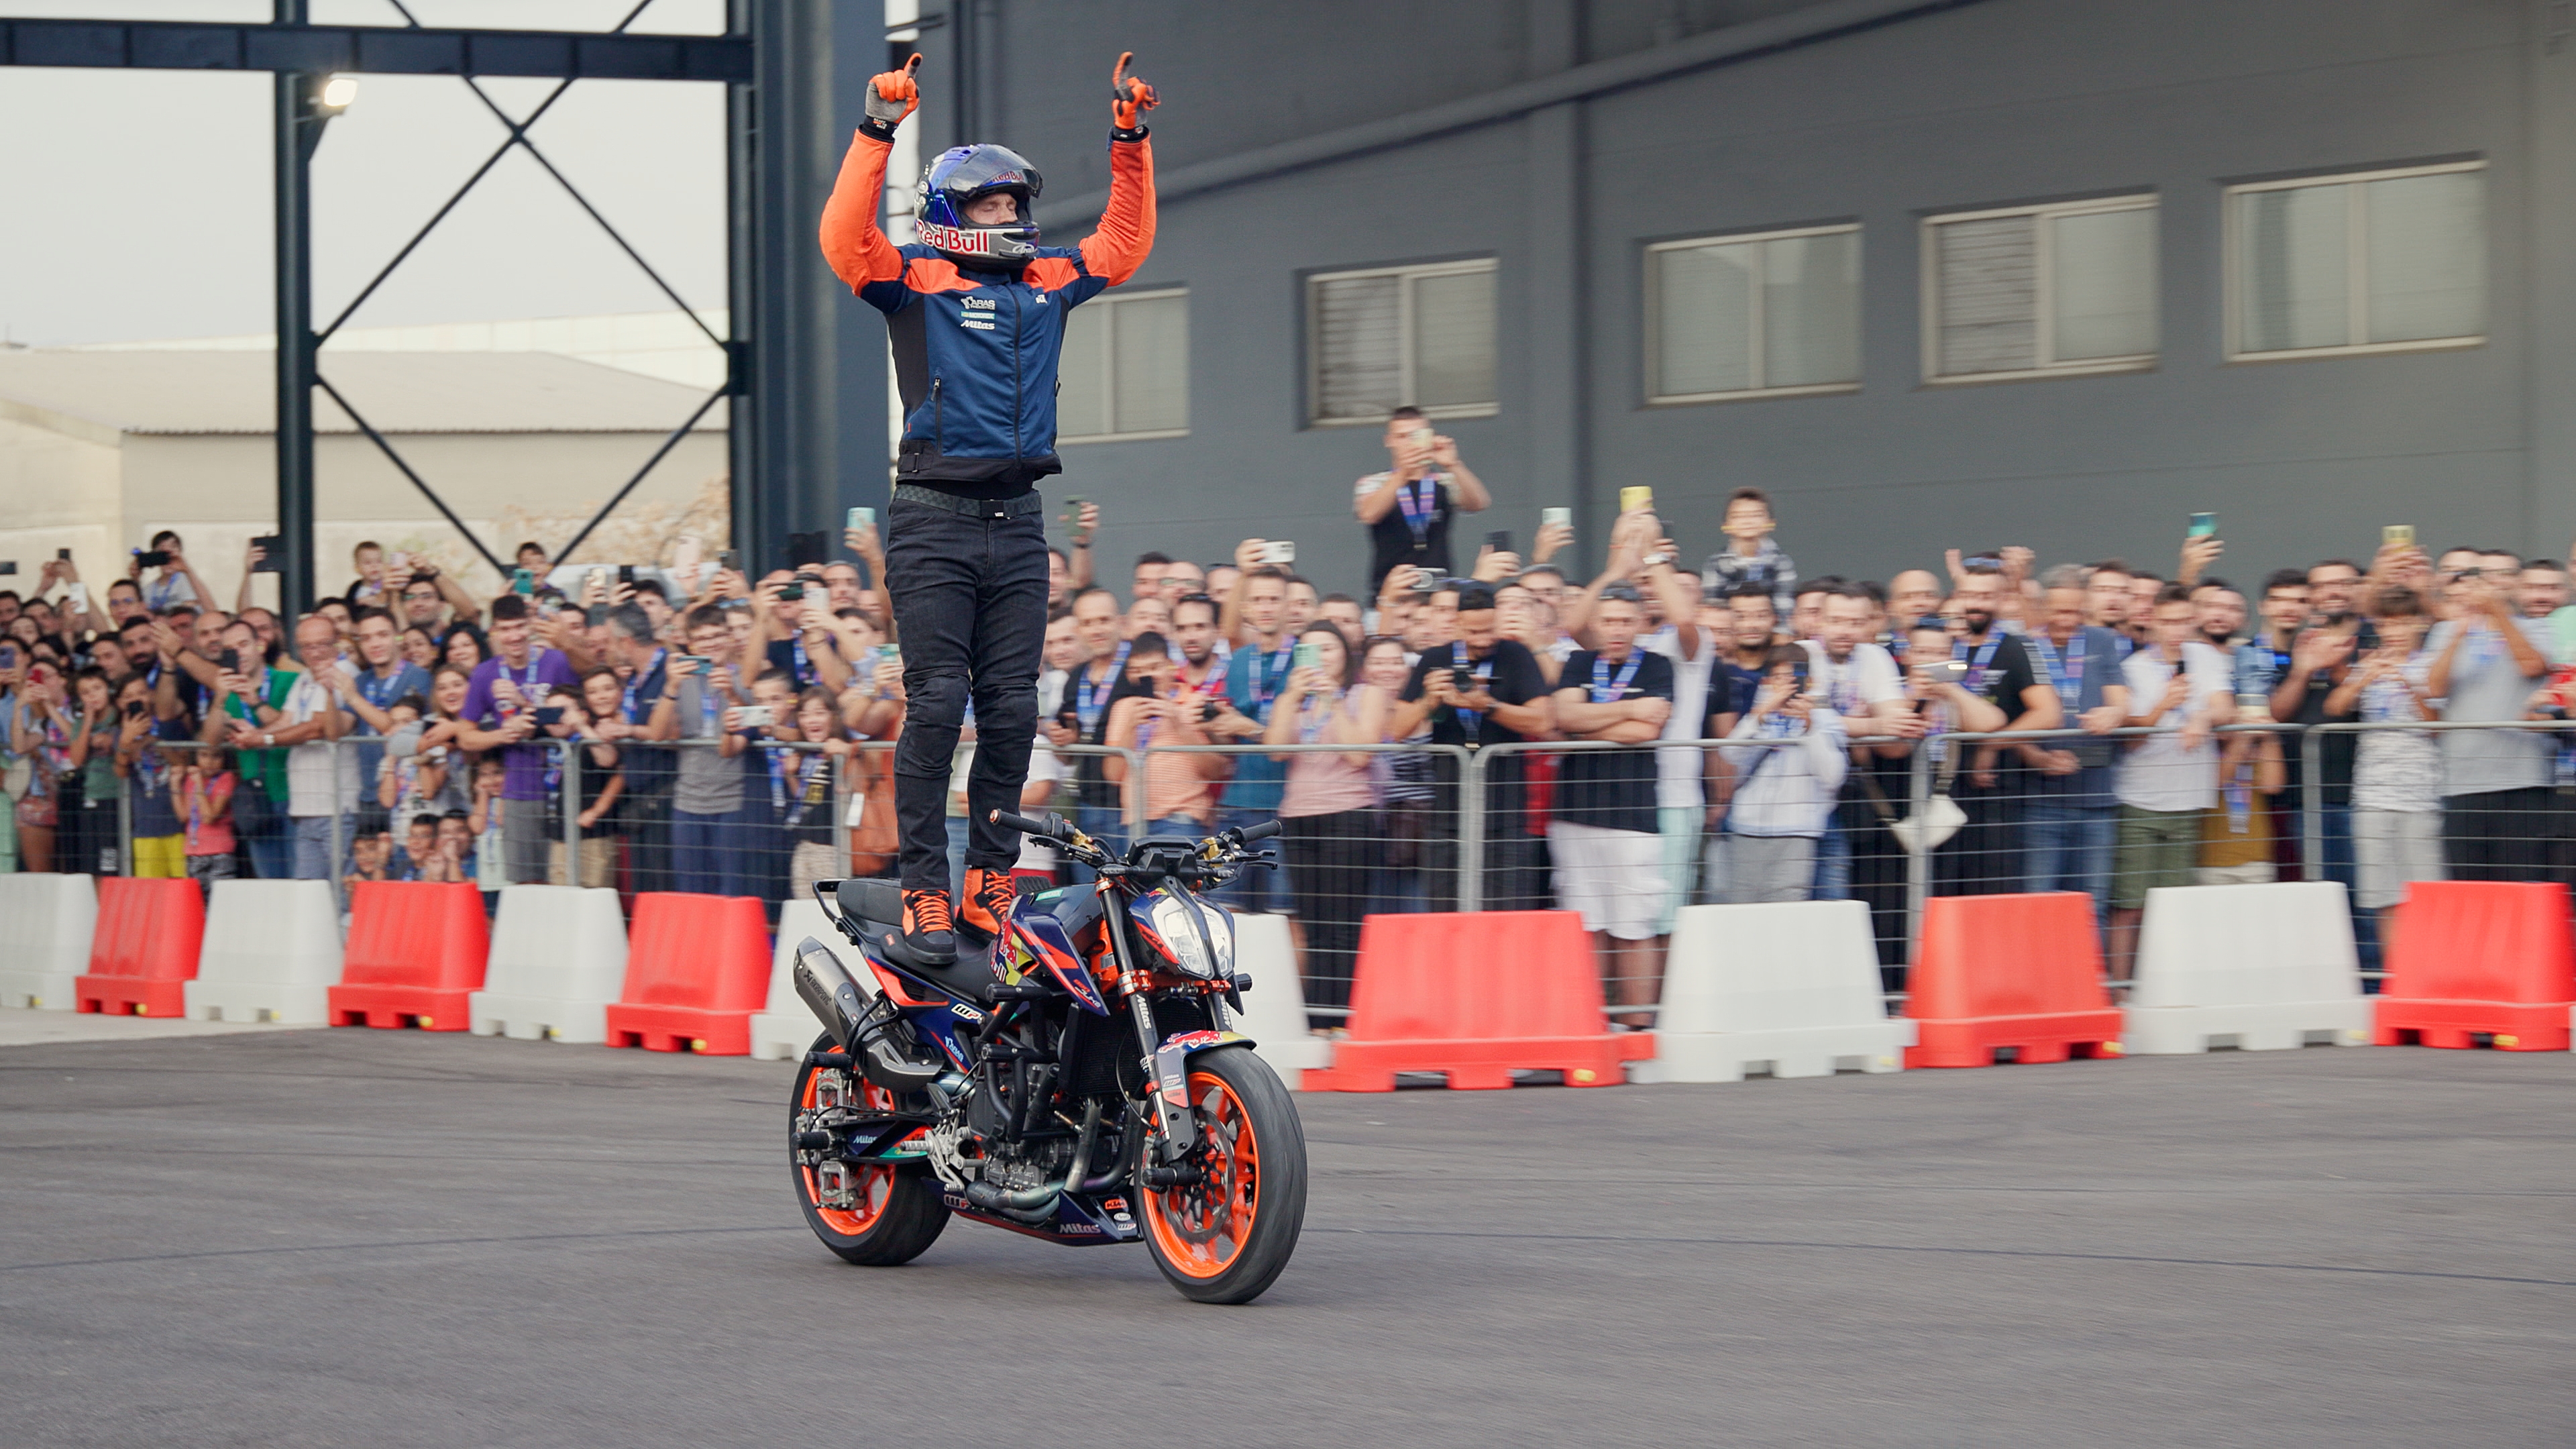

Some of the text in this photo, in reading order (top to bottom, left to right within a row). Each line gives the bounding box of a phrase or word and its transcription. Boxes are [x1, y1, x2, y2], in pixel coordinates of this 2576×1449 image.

[917, 220, 988, 253] Red Bull
[961, 320, 995, 330] Mitas
[954, 1005, 980, 1018] WP
[1136, 994, 1152, 1029] Mitas
[1219, 995, 1232, 1029] Mitas
[1060, 1223, 1101, 1234] Mitas
